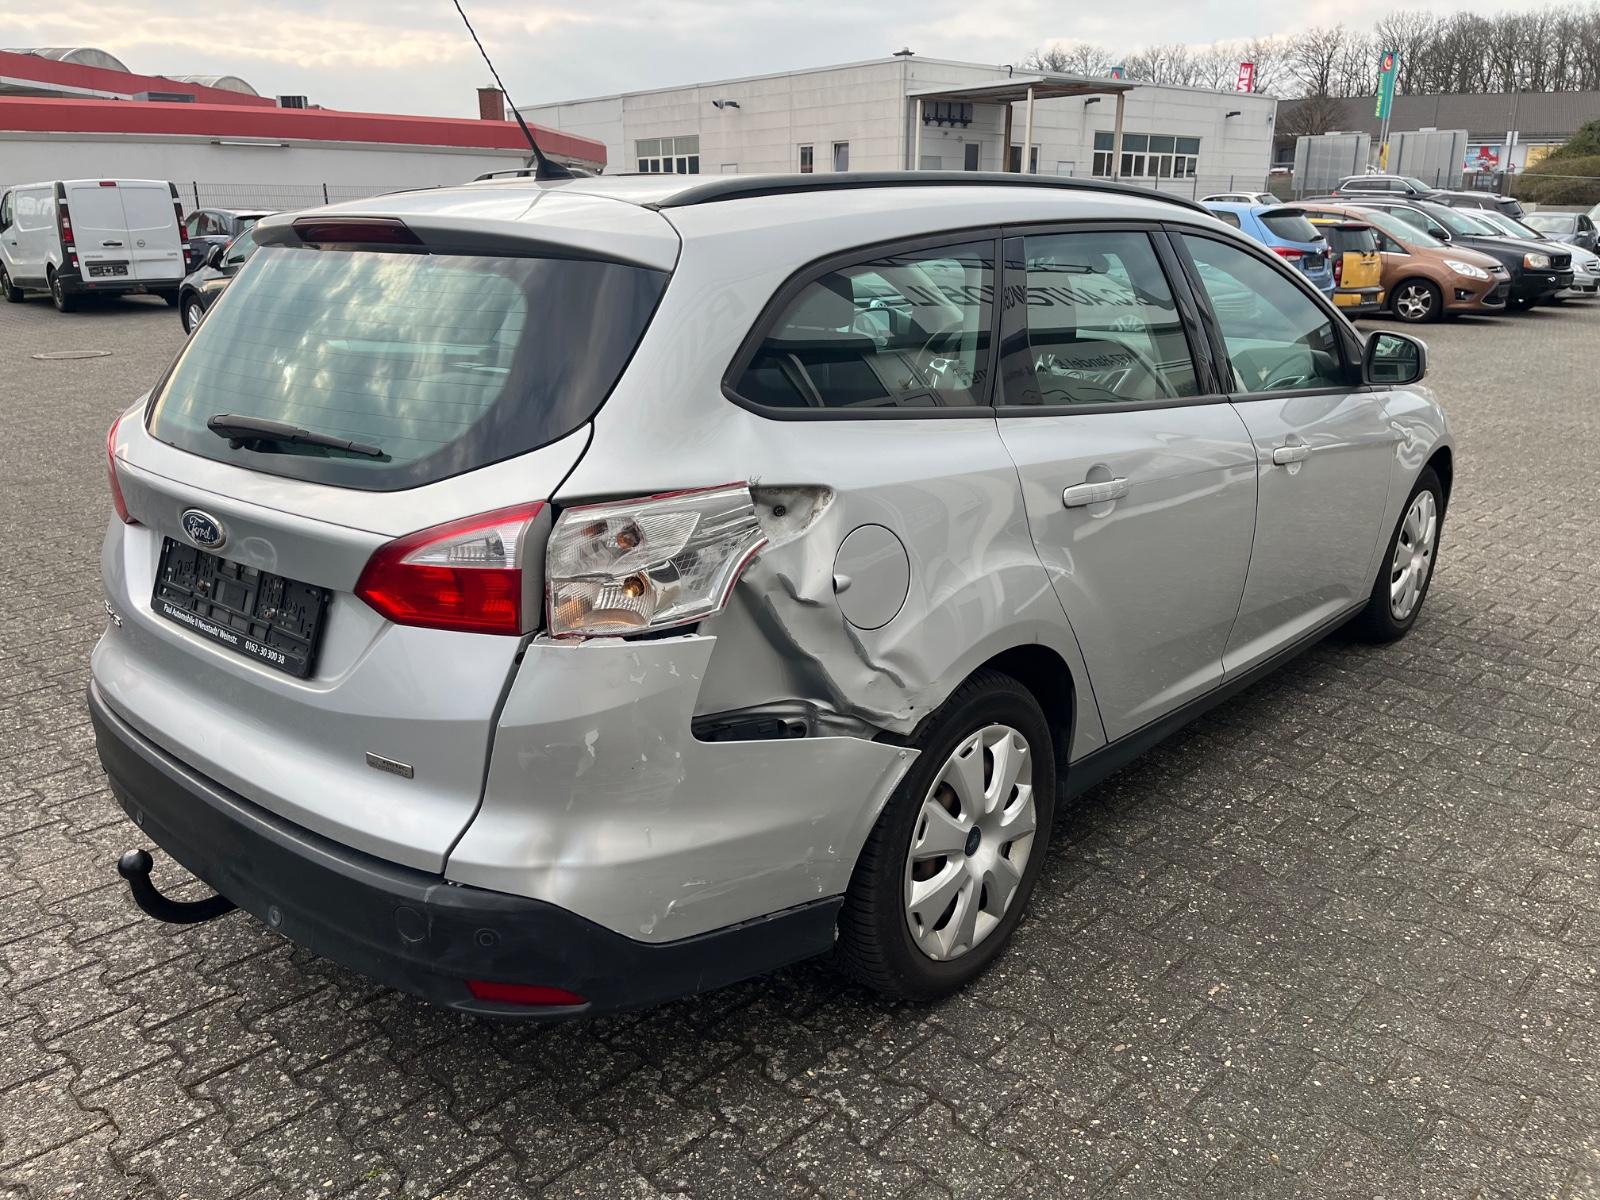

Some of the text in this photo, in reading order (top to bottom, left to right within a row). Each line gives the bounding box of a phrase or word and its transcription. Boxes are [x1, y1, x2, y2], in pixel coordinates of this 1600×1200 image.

[187, 515, 212, 540] Ford
[163, 603, 173, 614] Paul
[172, 607, 195, 625] Automobile
[267, 650, 278, 661] 300
[277, 654, 285, 664] 38
